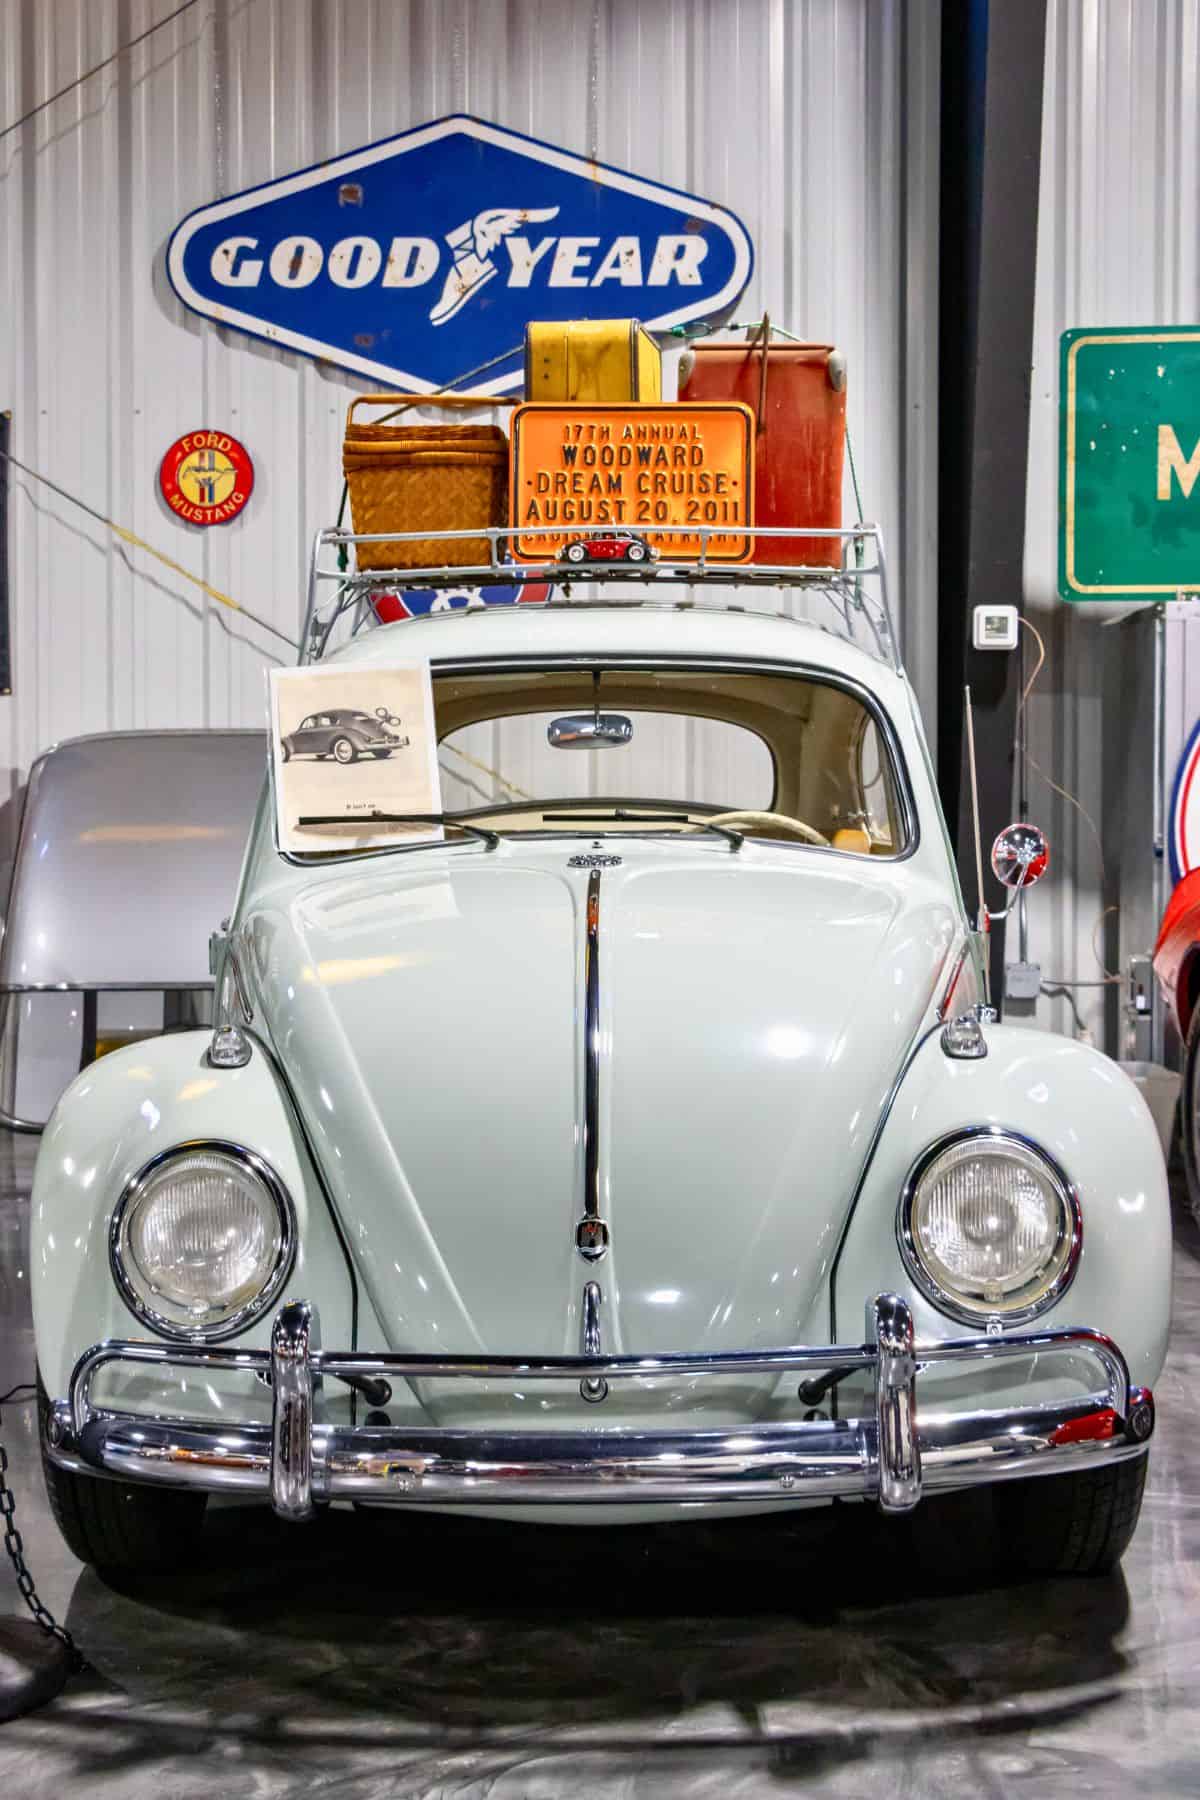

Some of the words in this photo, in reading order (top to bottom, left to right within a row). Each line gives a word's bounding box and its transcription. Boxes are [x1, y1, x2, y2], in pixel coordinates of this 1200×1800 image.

[210, 235, 441, 289] GOOD
[505, 234, 709, 288] YEAR
[181, 433, 232, 453] FORD
[565, 424, 610, 440] 17TH
[623, 424, 703, 440] ANNUAL
[562, 445, 704, 467] WOODWARD
[537, 472, 623, 495] DREAM
[637, 472, 729, 495] CRUISE
[169, 491, 244, 522] MUSTANG
[525, 499, 626, 521] AUGUST
[687, 499, 739, 521] 2011
